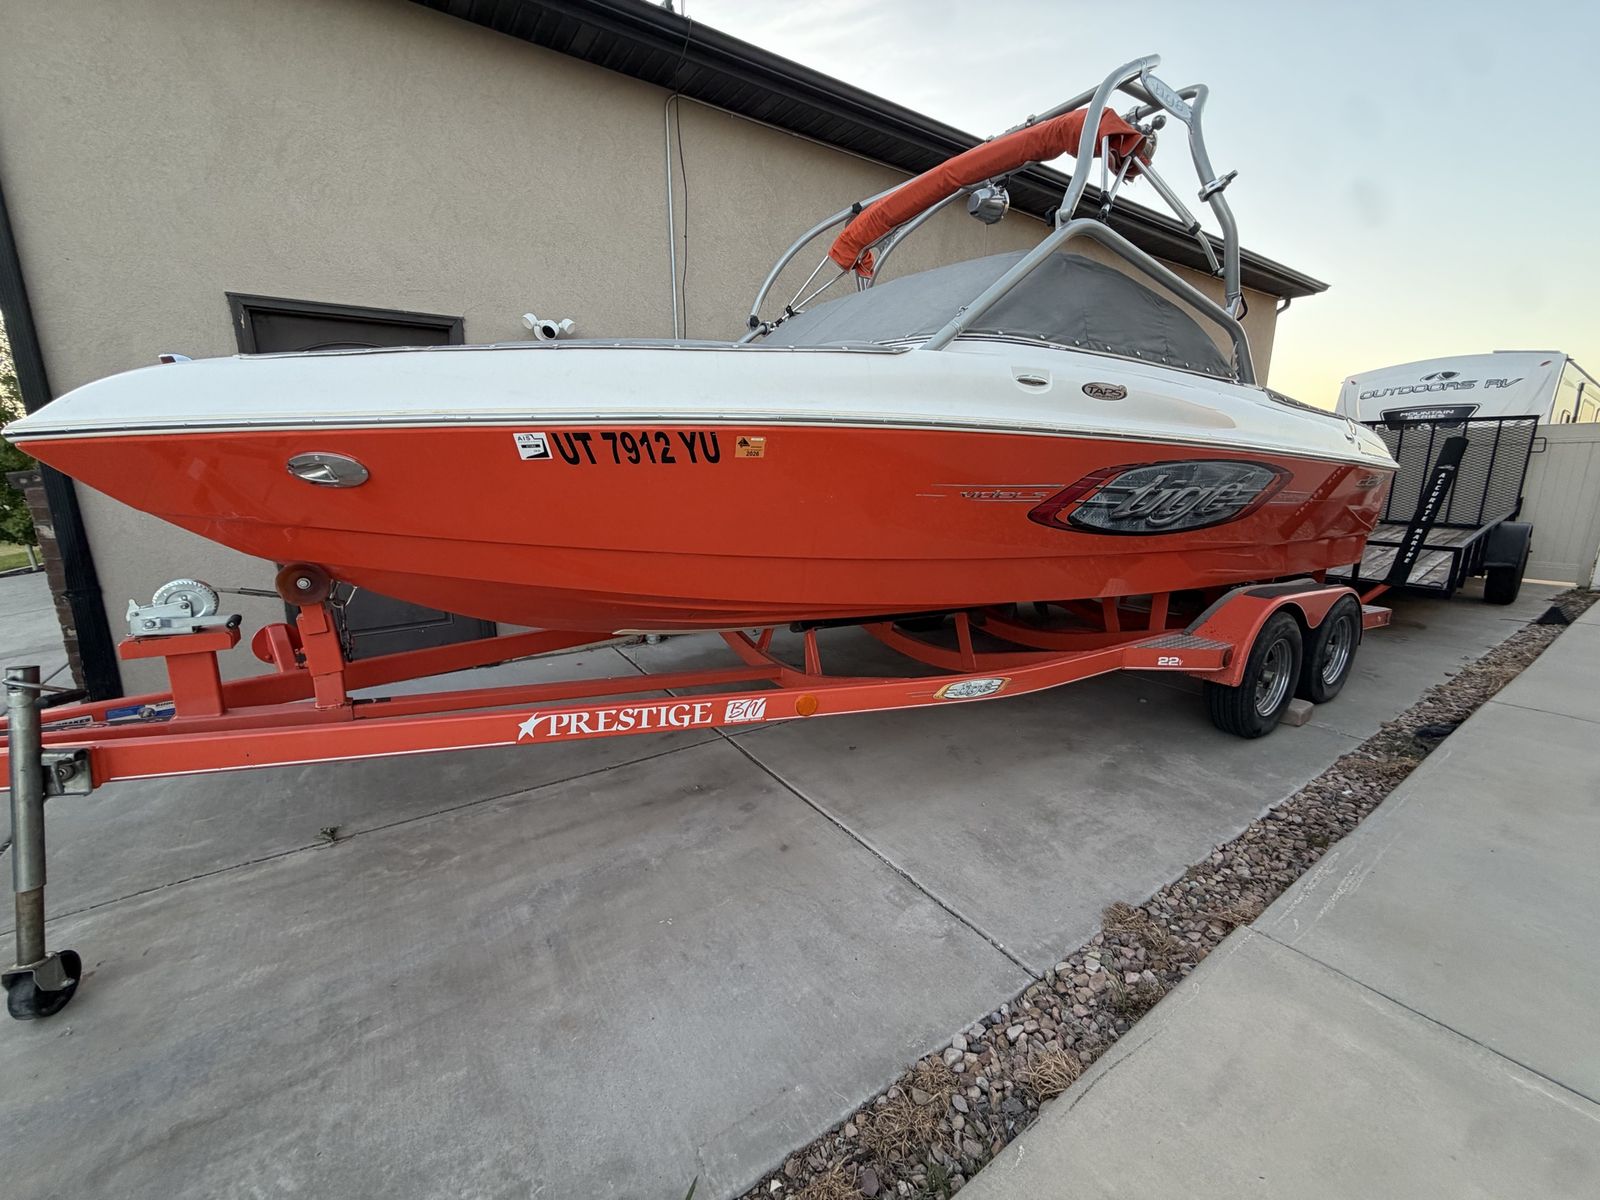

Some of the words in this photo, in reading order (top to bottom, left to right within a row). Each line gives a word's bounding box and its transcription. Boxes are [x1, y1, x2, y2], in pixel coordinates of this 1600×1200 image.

[1360, 380, 1479, 400] OUTDOORS
[1484, 377, 1525, 389] RV
[1400, 409, 1454, 417] MOUNTAIN
[551, 432, 597, 465] UT
[601, 431, 676, 465] 7912
[678, 431, 721, 464] YU
[1421, 472, 1446, 522] ACCURATE
[1403, 528, 1424, 564] MARINE
[546, 701, 713, 737] PRESTIGE
